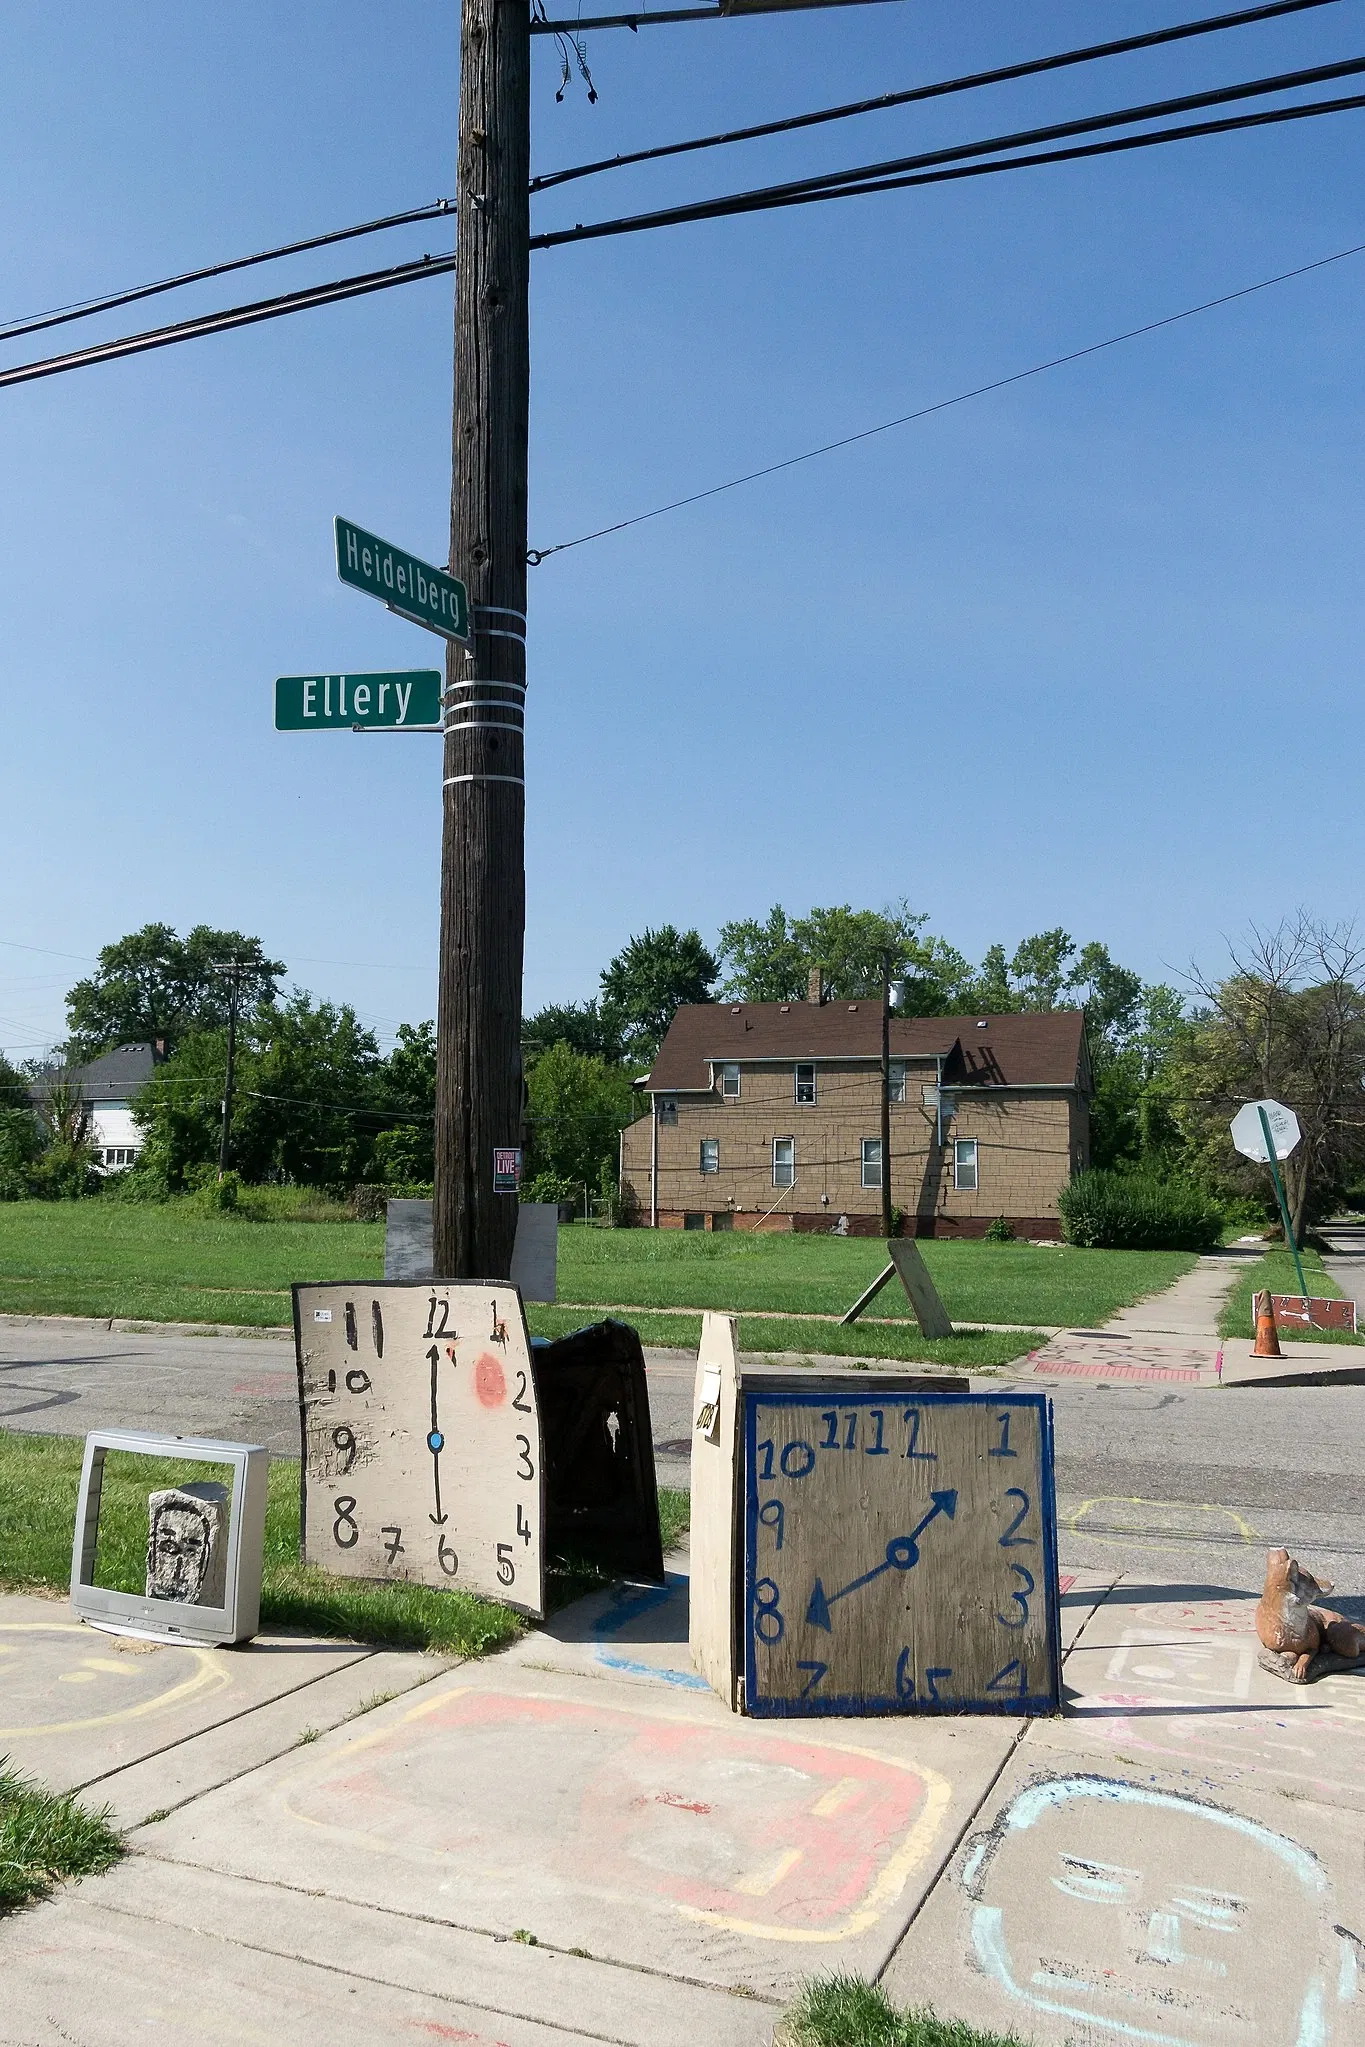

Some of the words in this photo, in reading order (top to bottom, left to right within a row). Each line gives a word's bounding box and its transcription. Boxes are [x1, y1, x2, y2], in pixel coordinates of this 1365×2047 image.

[346, 529, 459, 628] Heidelberg
[303, 676, 412, 724] Ellery
[497, 1160, 515, 1174] LIVE
[422, 1297, 456, 1339] 12
[490, 1300, 500, 1341] 1
[1325, 1301, 1331, 1312] 1
[346, 1300, 384, 1358] 11
[328, 1369, 370, 1393] 10
[512, 1371, 532, 1413] 2
[332, 1426, 356, 1475] 9
[819, 1410, 858, 1450] 11
[865, 1408, 938, 1461] 12
[987, 1412, 1018, 1457] 1
[516, 1434, 535, 1481] 3
[756, 1439, 816, 1480] 10
[333, 1496, 359, 1549] 8
[516, 1504, 532, 1546] 4
[759, 1500, 785, 1550] 9
[998, 1488, 1036, 1547] 2
[381, 1527, 405, 1564] 7
[438, 1534, 459, 1576] 6
[496, 1543, 515, 1586] 5
[755, 1577, 785, 1645] 8
[997, 1563, 1035, 1630] 3
[796, 1661, 828, 1698] 7
[896, 1646, 915, 1699] 6
[925, 1668, 952, 1701] 5
[985, 1659, 1028, 1694] 4
